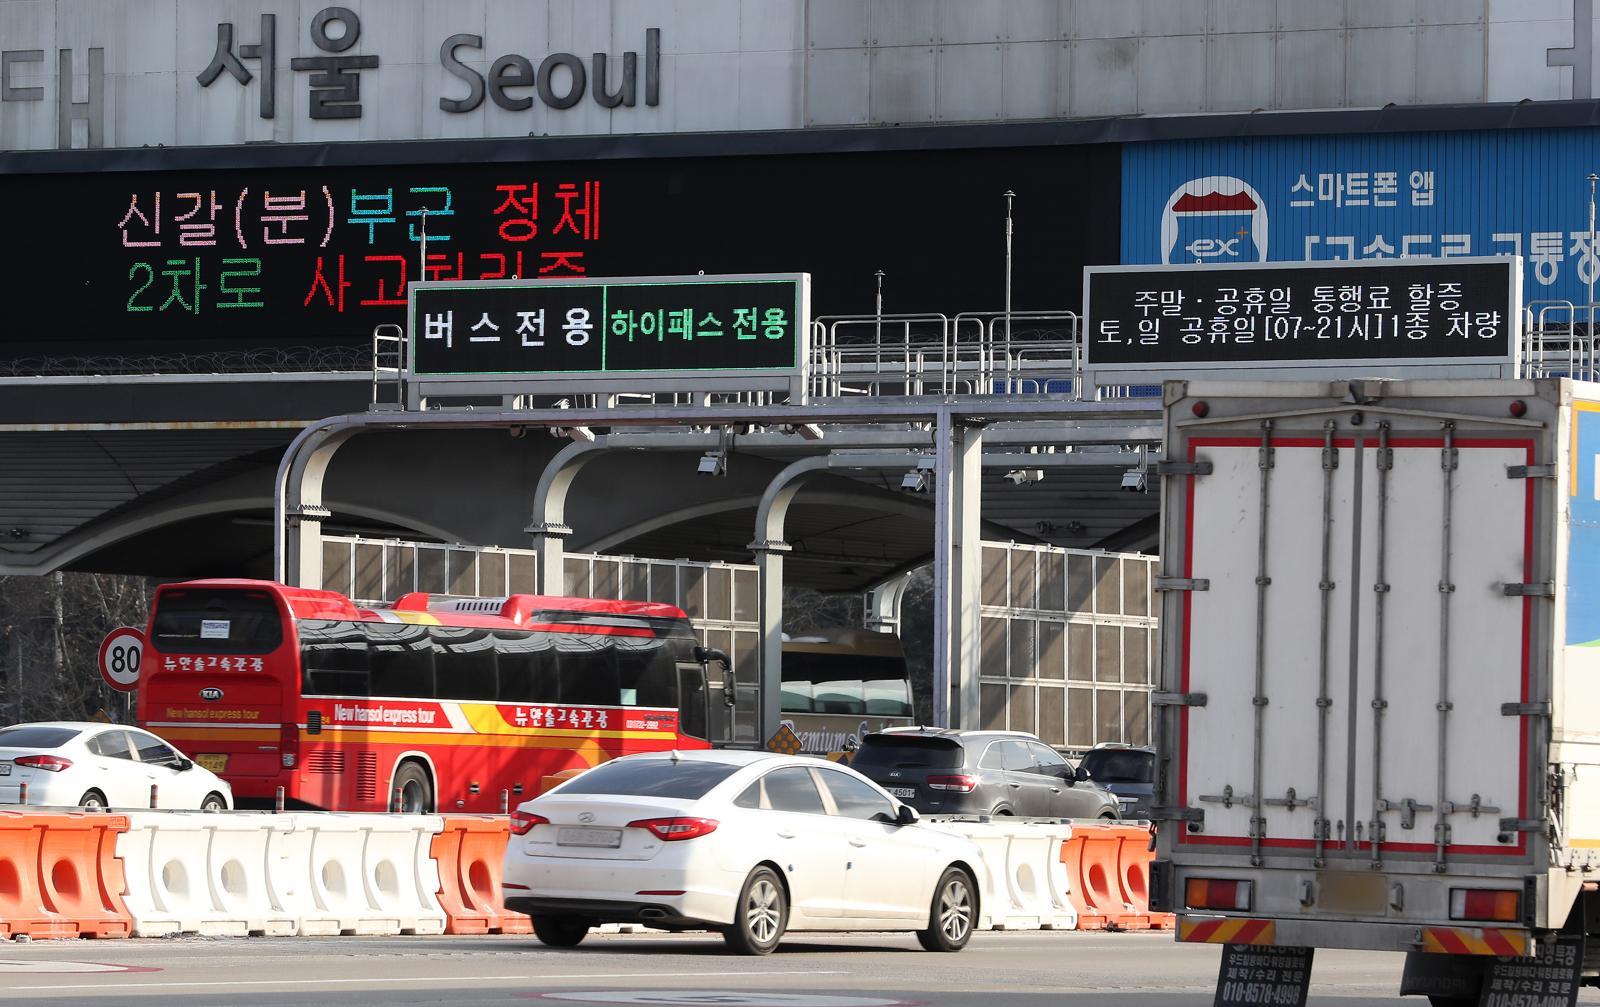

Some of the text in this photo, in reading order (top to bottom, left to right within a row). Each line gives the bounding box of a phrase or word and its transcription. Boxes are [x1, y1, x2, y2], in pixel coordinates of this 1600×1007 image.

[197, 7, 379, 119] 서울
[440, 28, 660, 113] Seoul
[1290, 170, 1434, 208] 스마트폰 앱
[494, 181, 600, 242] 정체
[127, 257, 264, 314] 2차로
[1312, 286, 1391, 313] 통행료
[1408, 283, 1462, 311] 할증
[611, 307, 788, 342] 하이패스 전용
[1098, 318, 1160, 346] 토,일
[1446, 311, 1501, 339] 차량
[112, 645, 140, 673] 80
[202, 690, 219, 699] KIA
[334, 704, 353, 721] New
[355, 704, 383, 722] hansol
[384, 708, 417, 725] express
[418, 707, 435, 723] tour
